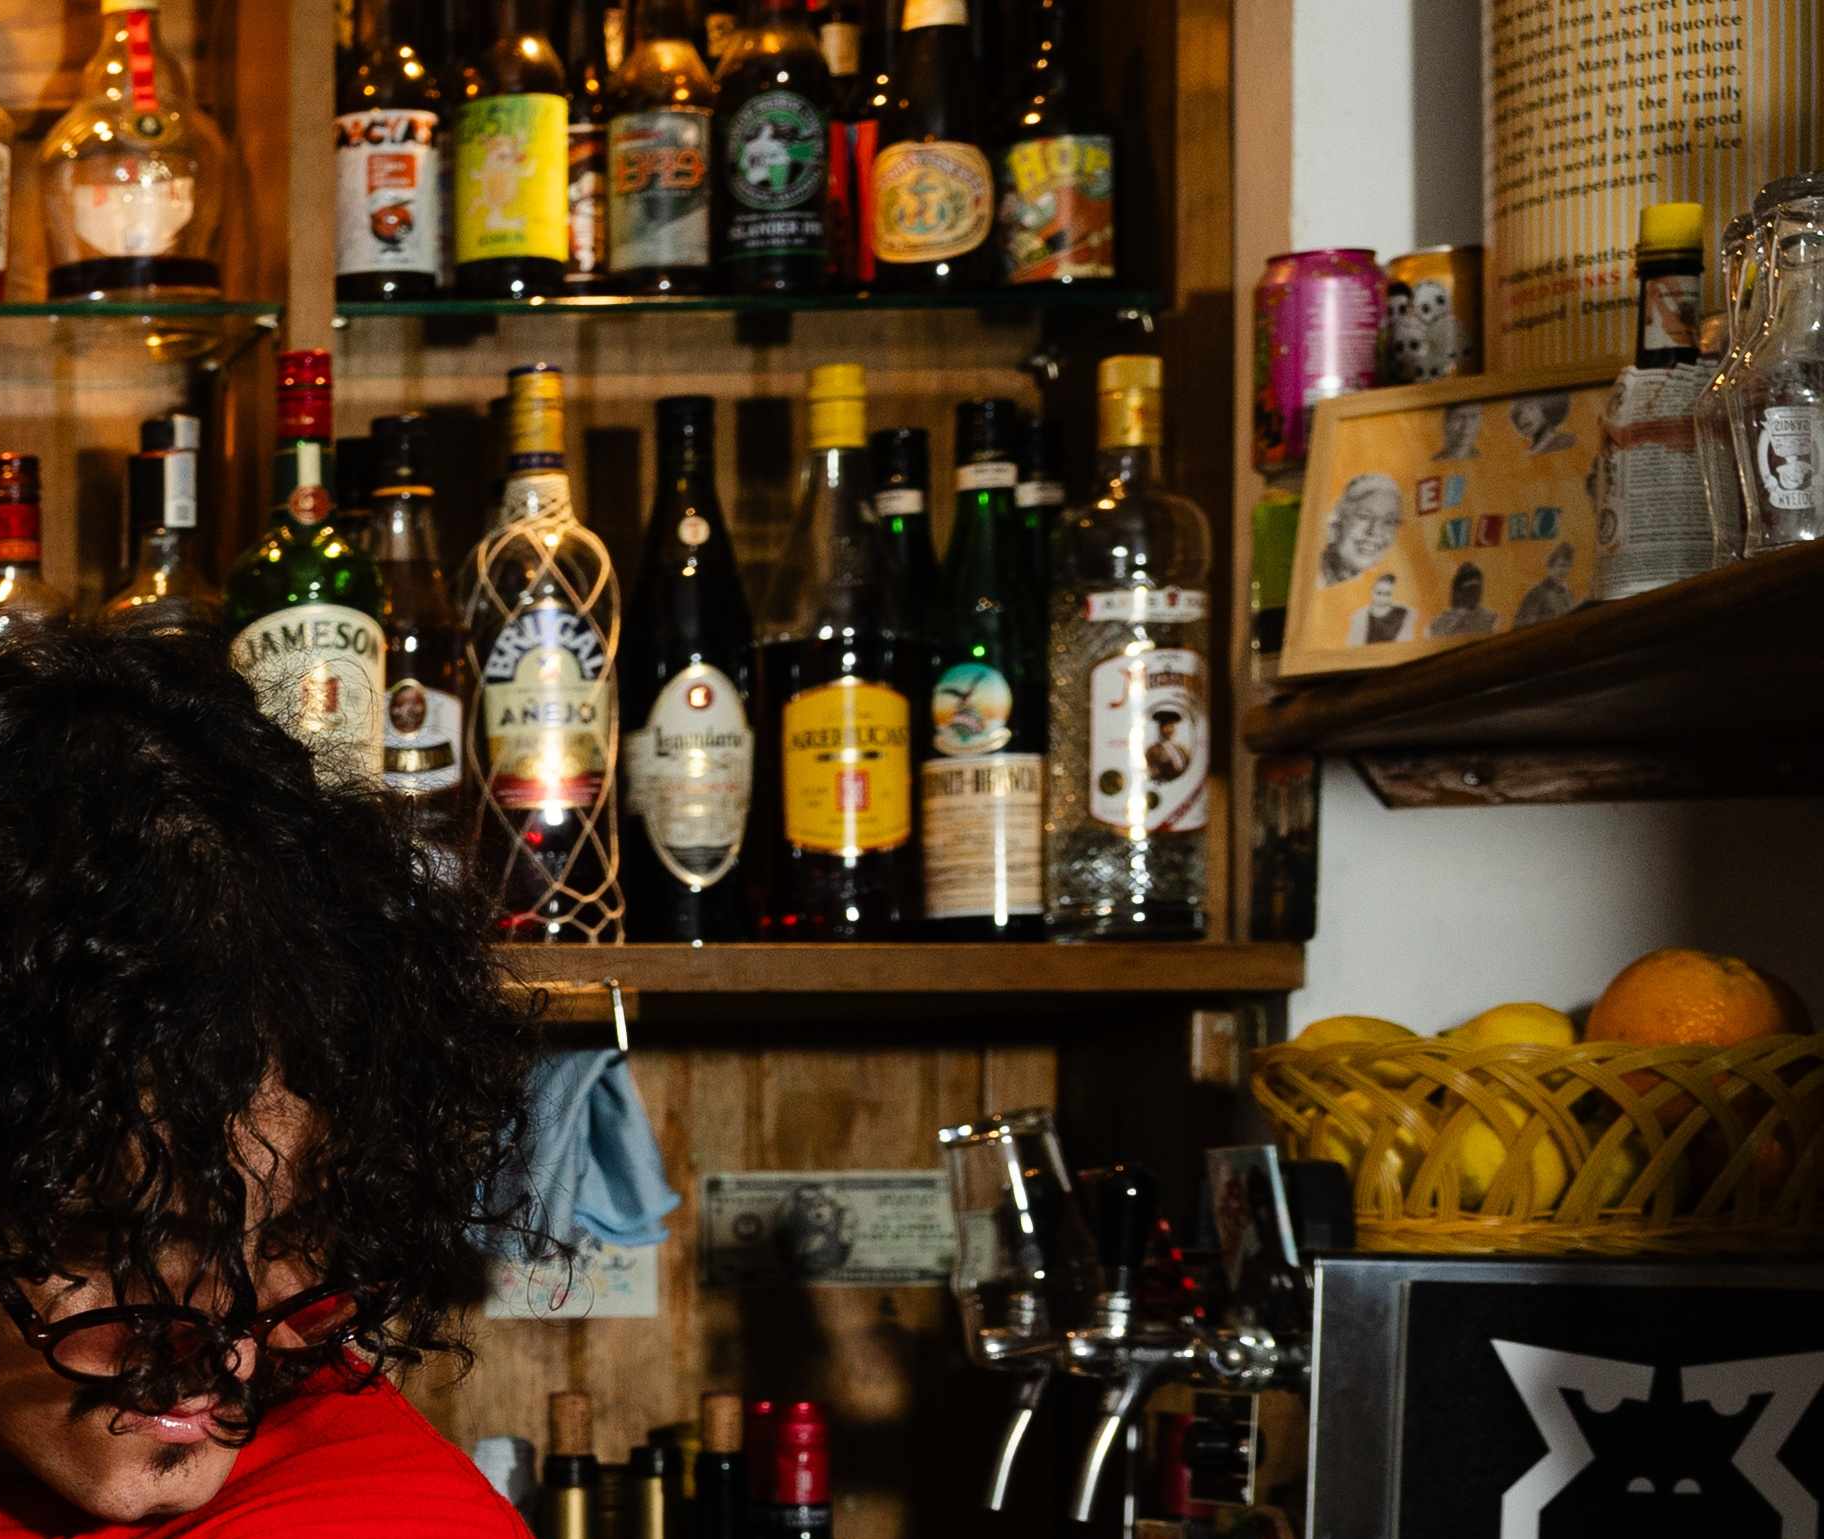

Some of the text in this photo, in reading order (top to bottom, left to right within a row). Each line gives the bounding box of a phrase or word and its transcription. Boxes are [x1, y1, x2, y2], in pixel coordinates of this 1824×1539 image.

[1657, 14, 1743, 34] liquorice
[1624, 45, 1668, 62] have
[1671, 38, 1743, 57] without
[1607, 72, 1668, 94] unique
[1675, 63, 1742, 82] recipe.
[1637, 95, 1667, 111] the
[1682, 85, 1742, 105] family
[1639, 118, 1687, 136] many
[1693, 110, 1742, 129] good
[1653, 140, 1692, 157] shot
[1712, 135, 1743, 151] ice
[485, 611, 608, 683] BRUGAL
[499, 701, 597, 727] AÑEJO
